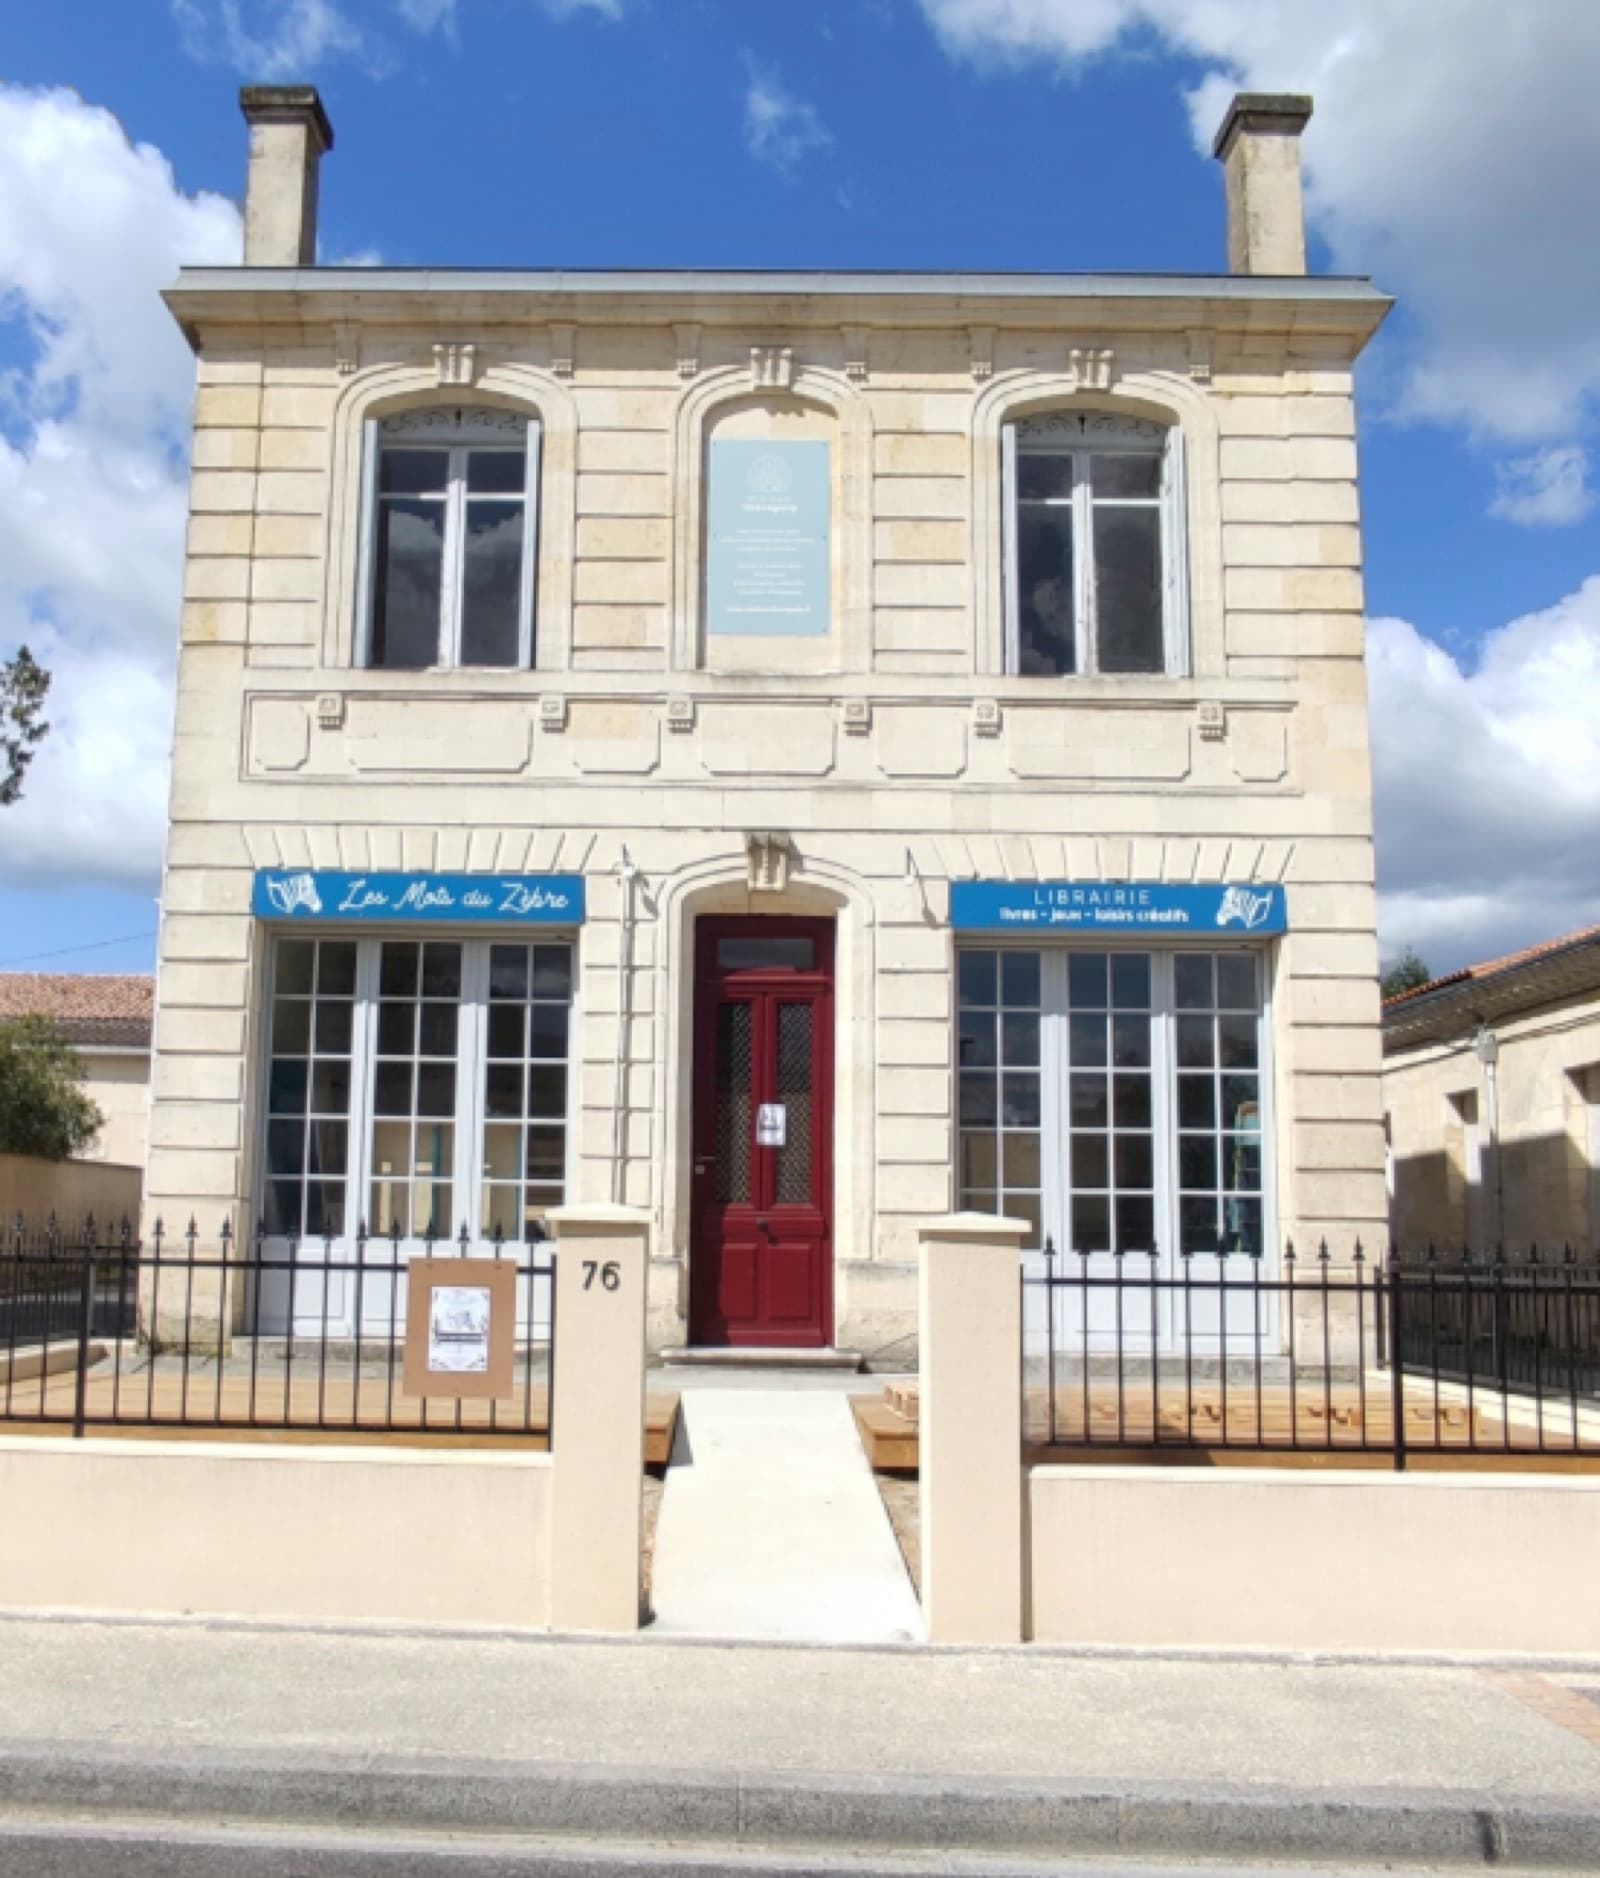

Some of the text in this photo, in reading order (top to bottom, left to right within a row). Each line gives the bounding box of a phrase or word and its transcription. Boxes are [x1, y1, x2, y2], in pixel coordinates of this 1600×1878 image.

[338, 878, 389, 911] Les
[391, 880, 456, 911] Mots
[463, 887, 493, 907] du
[1034, 888, 1151, 905] LIBRAIRIE
[999, 905, 1038, 921] livres
[1095, 906, 1134, 922] loisirs
[581, 1260, 622, 1292] 76
